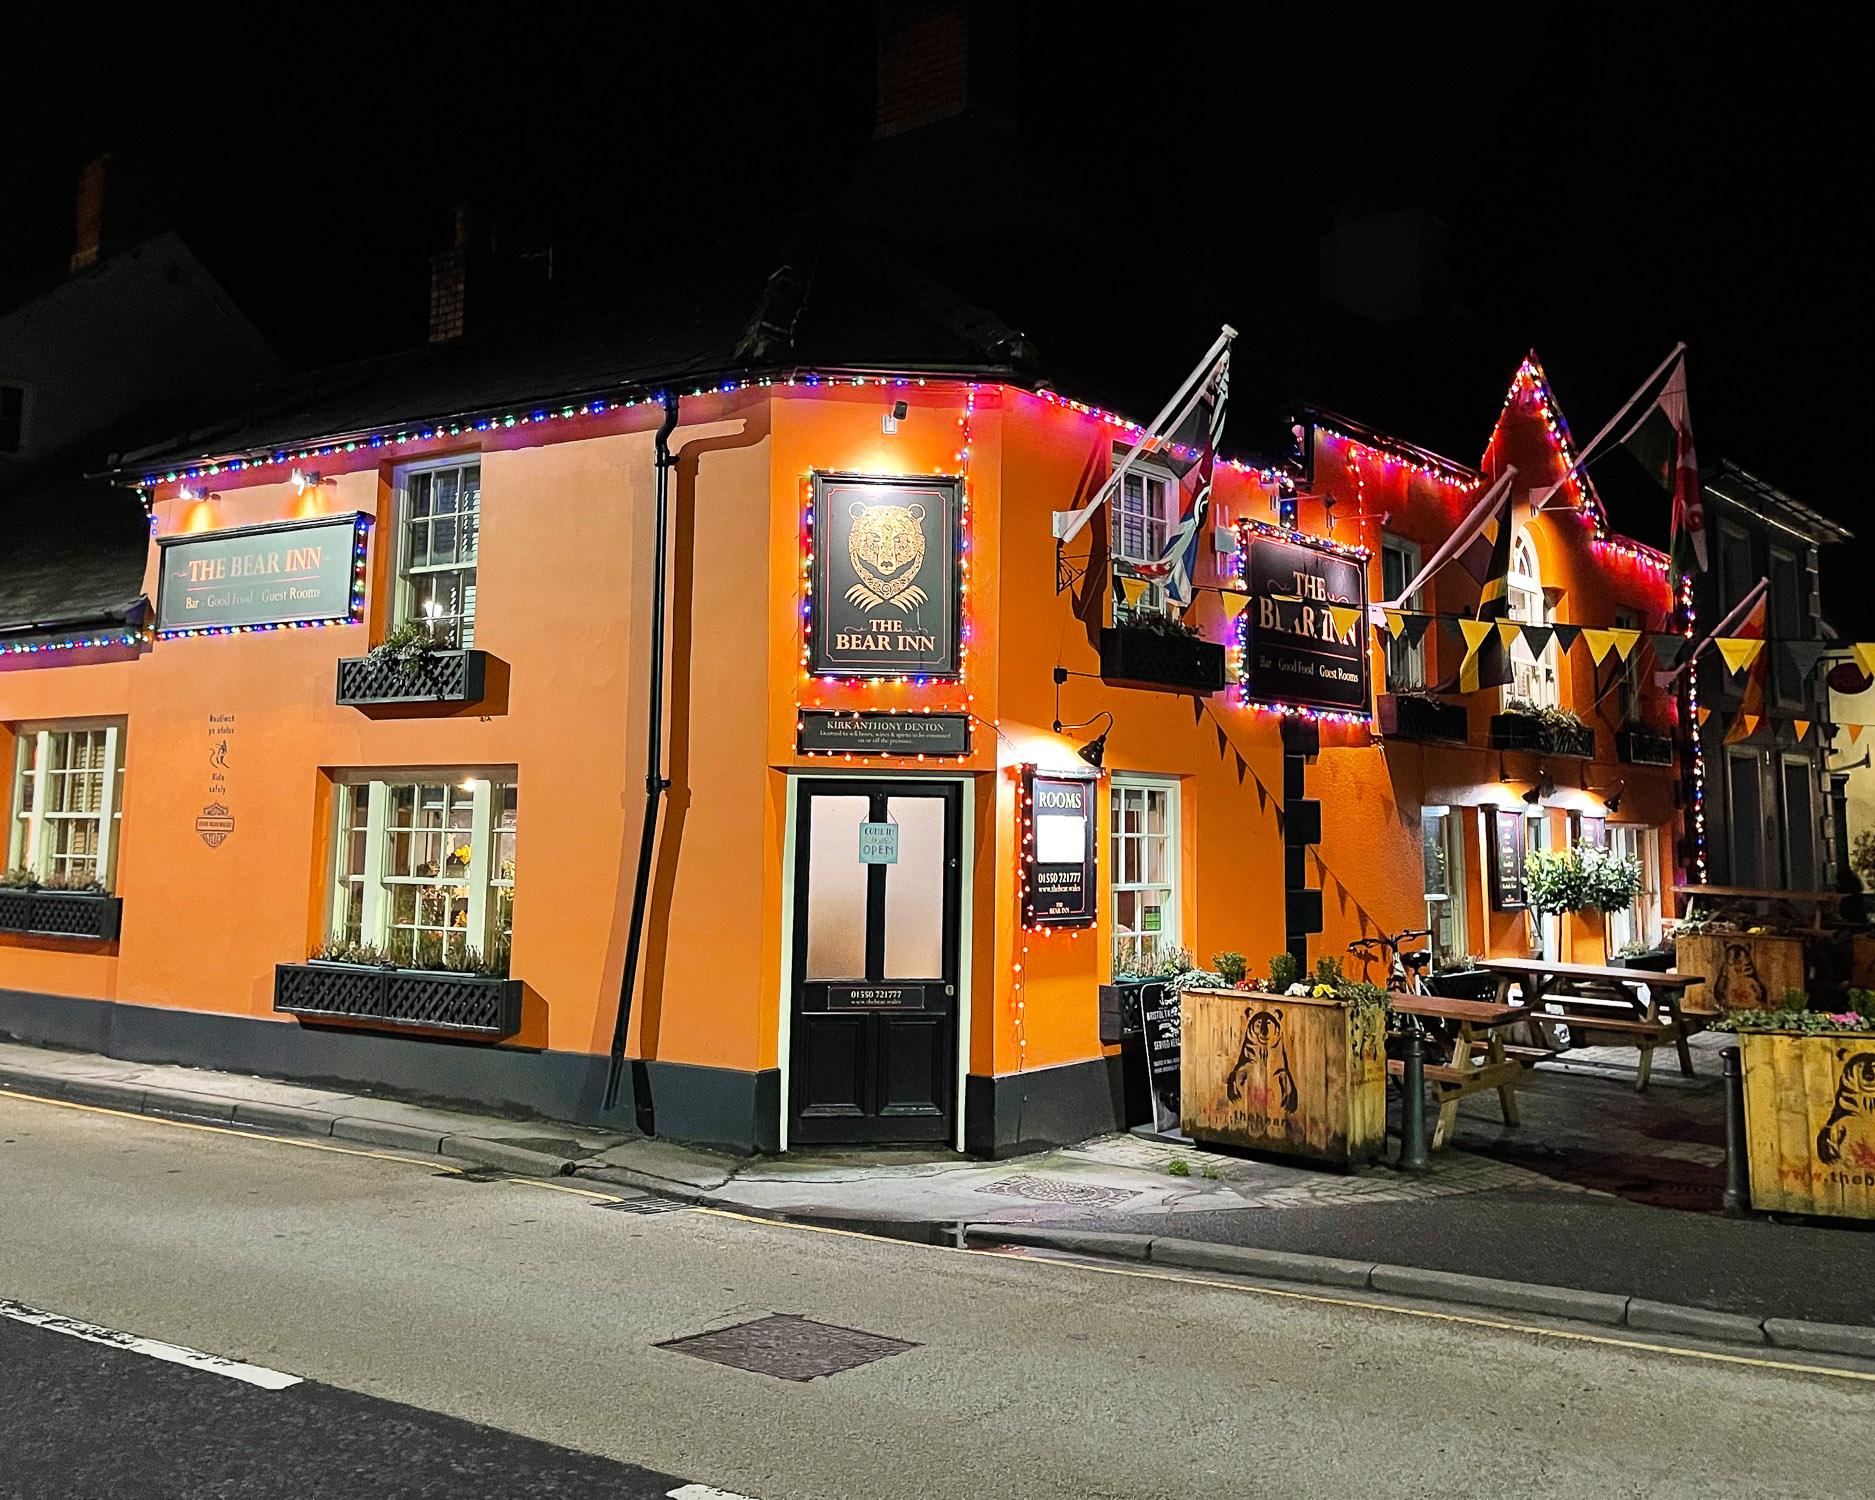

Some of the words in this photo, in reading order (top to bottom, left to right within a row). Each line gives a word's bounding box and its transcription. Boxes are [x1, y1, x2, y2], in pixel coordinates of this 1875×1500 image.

[189, 558, 226, 582] THE
[230, 552, 280, 577] BEAR
[284, 546, 322, 572] INN
[1293, 571, 1326, 601] THE
[186, 597, 200, 609] Bar
[207, 592, 230, 607] Good
[232, 590, 254, 604] Food
[261, 588, 287, 603] Guest
[289, 586, 321, 600] Rooms
[869, 619, 902, 632] THE
[835, 634, 892, 650] BEAR
[897, 635, 935, 651] INN
[1260, 655, 1272, 668] Bar
[1278, 659, 1297, 673] Good
[1298, 661, 1315, 676] Food
[1319, 665, 1337, 680] Guest
[1338, 667, 1359, 683] Rooms
[827, 721, 851, 729] KIRK
[853, 721, 902, 731] ANTHONY
[904, 722, 944, 731] DENTON
[1038, 791, 1082, 809] ROOMS
[863, 845, 894, 855] OPEN
[1038, 872, 1058, 883] 01550
[1058, 872, 1081, 883] 721777
[851, 990, 874, 998] 01550
[875, 990, 902, 998] 721777
